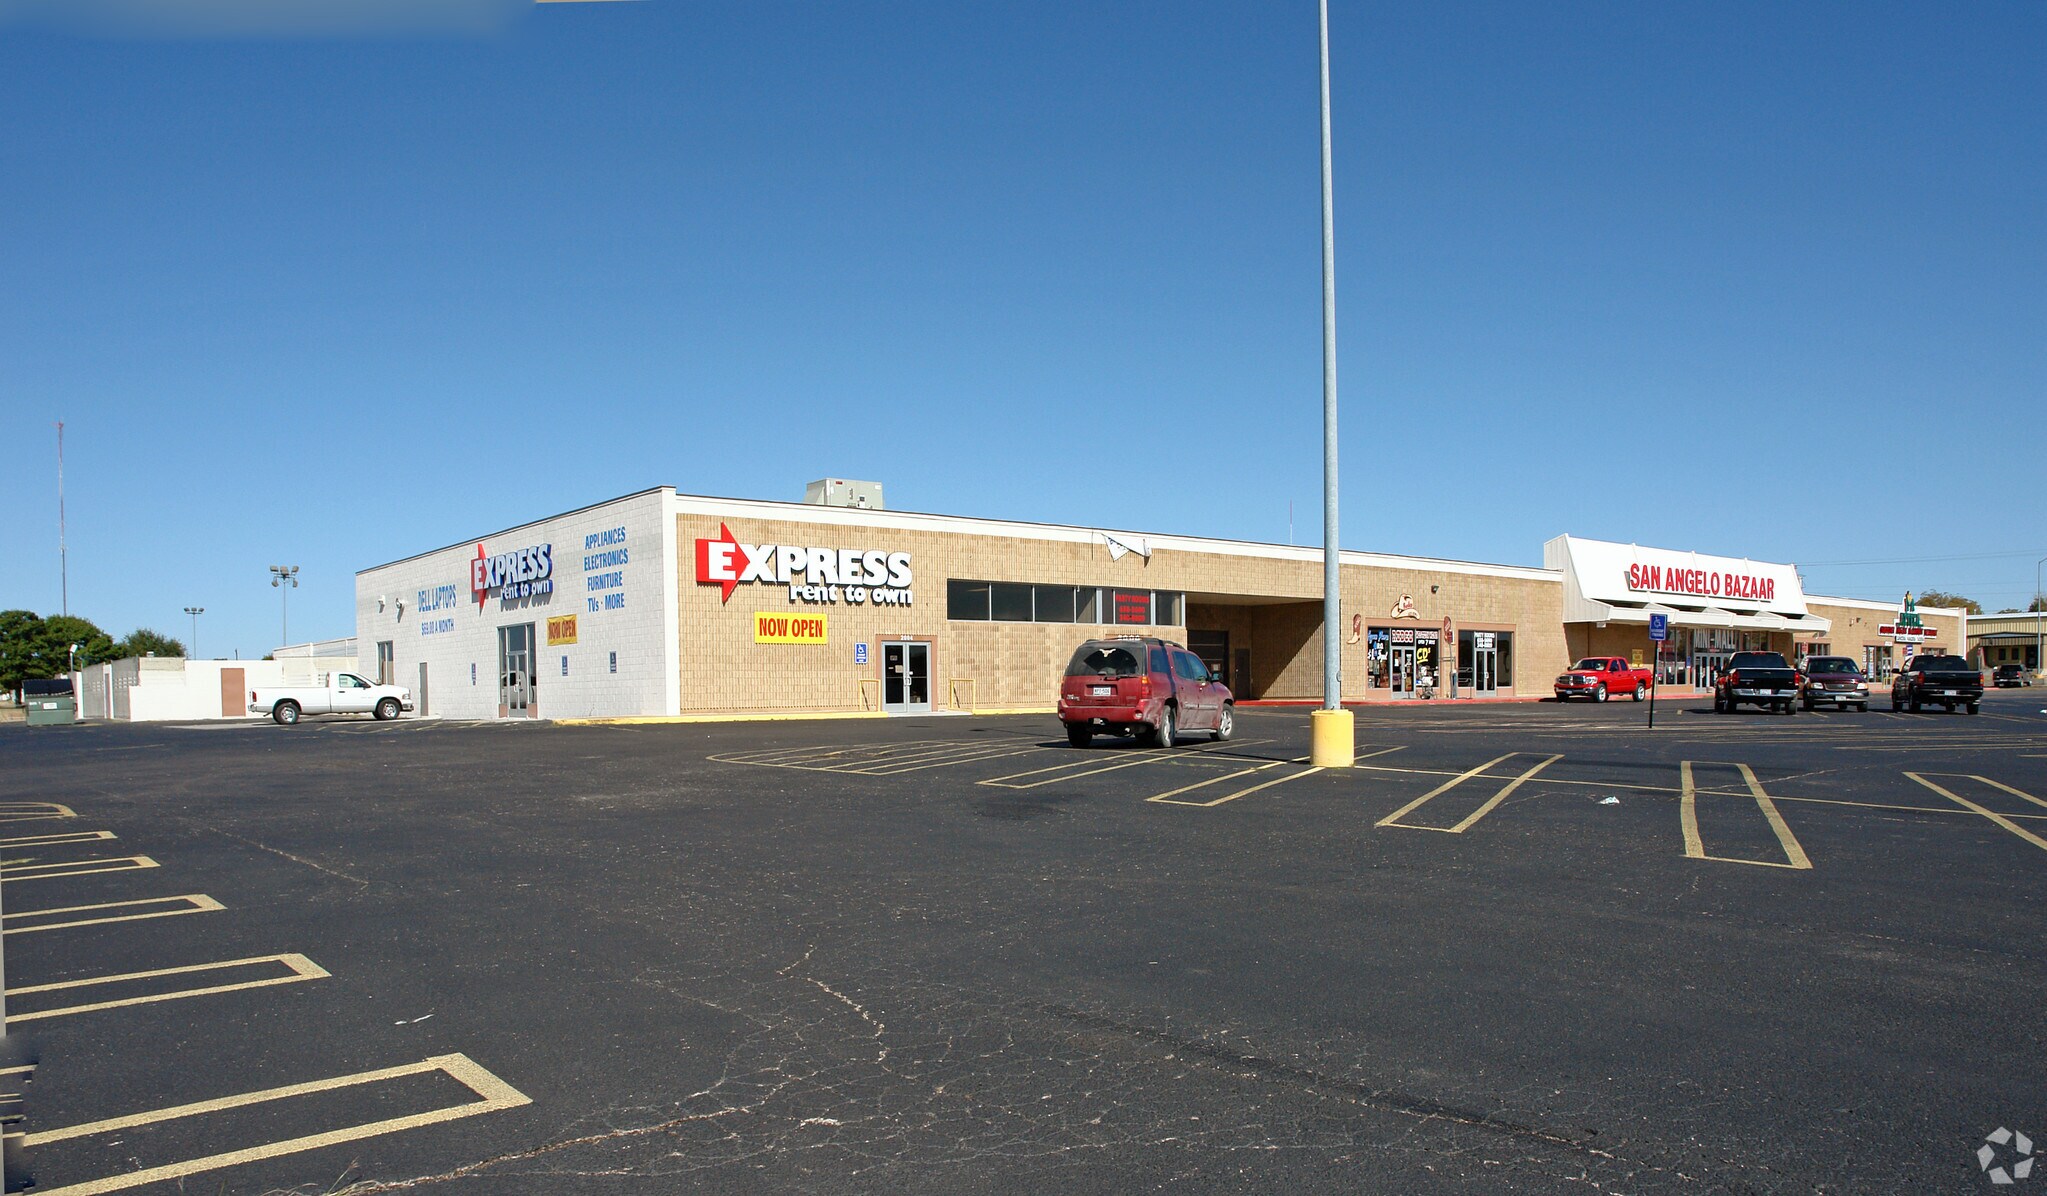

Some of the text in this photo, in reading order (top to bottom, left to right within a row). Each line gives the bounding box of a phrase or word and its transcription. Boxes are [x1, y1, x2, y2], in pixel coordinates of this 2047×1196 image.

[585, 526, 626, 550] APPLIANCES
[474, 543, 552, 590] EXPRESS
[584, 548, 629, 571] ELECTRONICS
[708, 541, 913, 587] EXPRESS
[501, 580, 550, 600] rent to own
[587, 571, 623, 592] FURNITURE
[1630, 563, 1775, 600] SAN ANGELO BAZAAR
[432, 584, 456, 610] LAPTOPS
[588, 593, 625, 613] TVs MORE
[790, 585, 913, 604] rent to own
[549, 620, 576, 640] NOW OPEN
[759, 618, 823, 638] NOW OPEN
